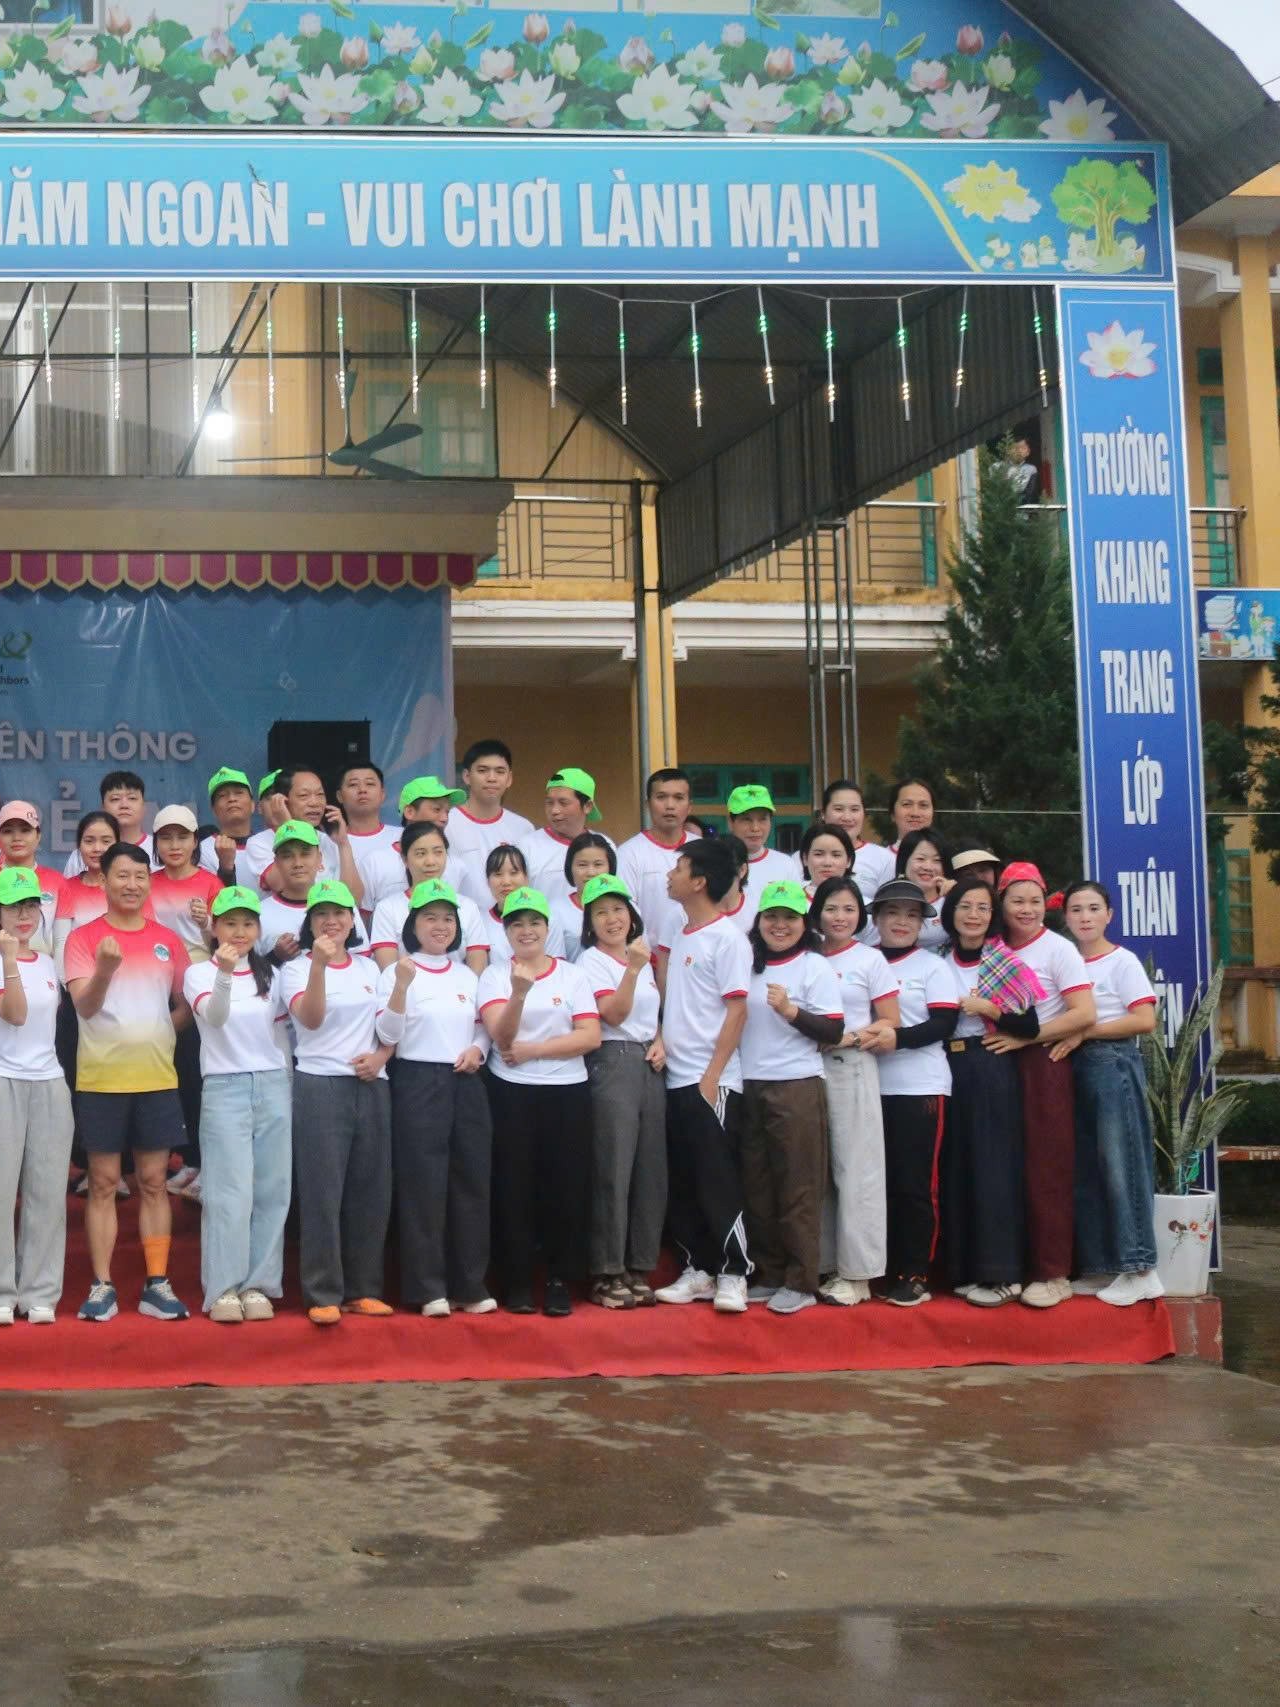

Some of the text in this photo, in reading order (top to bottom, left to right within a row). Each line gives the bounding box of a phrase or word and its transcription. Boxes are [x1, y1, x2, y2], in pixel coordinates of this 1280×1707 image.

[106, 181, 289, 247] NGOAN
[342, 182, 426, 247] VUI
[442, 177, 562, 248] CHƠI
[578, 168, 713, 248] LÀNH
[726, 184, 879, 263] MẠNH
[1081, 414, 1171, 496] TRƯỜNG
[1094, 540, 1171, 604] KHANG
[1099, 649, 1176, 715] TRANG
[1121, 739, 1164, 826] LỚP
[1117, 857, 1178, 936] THÂN
